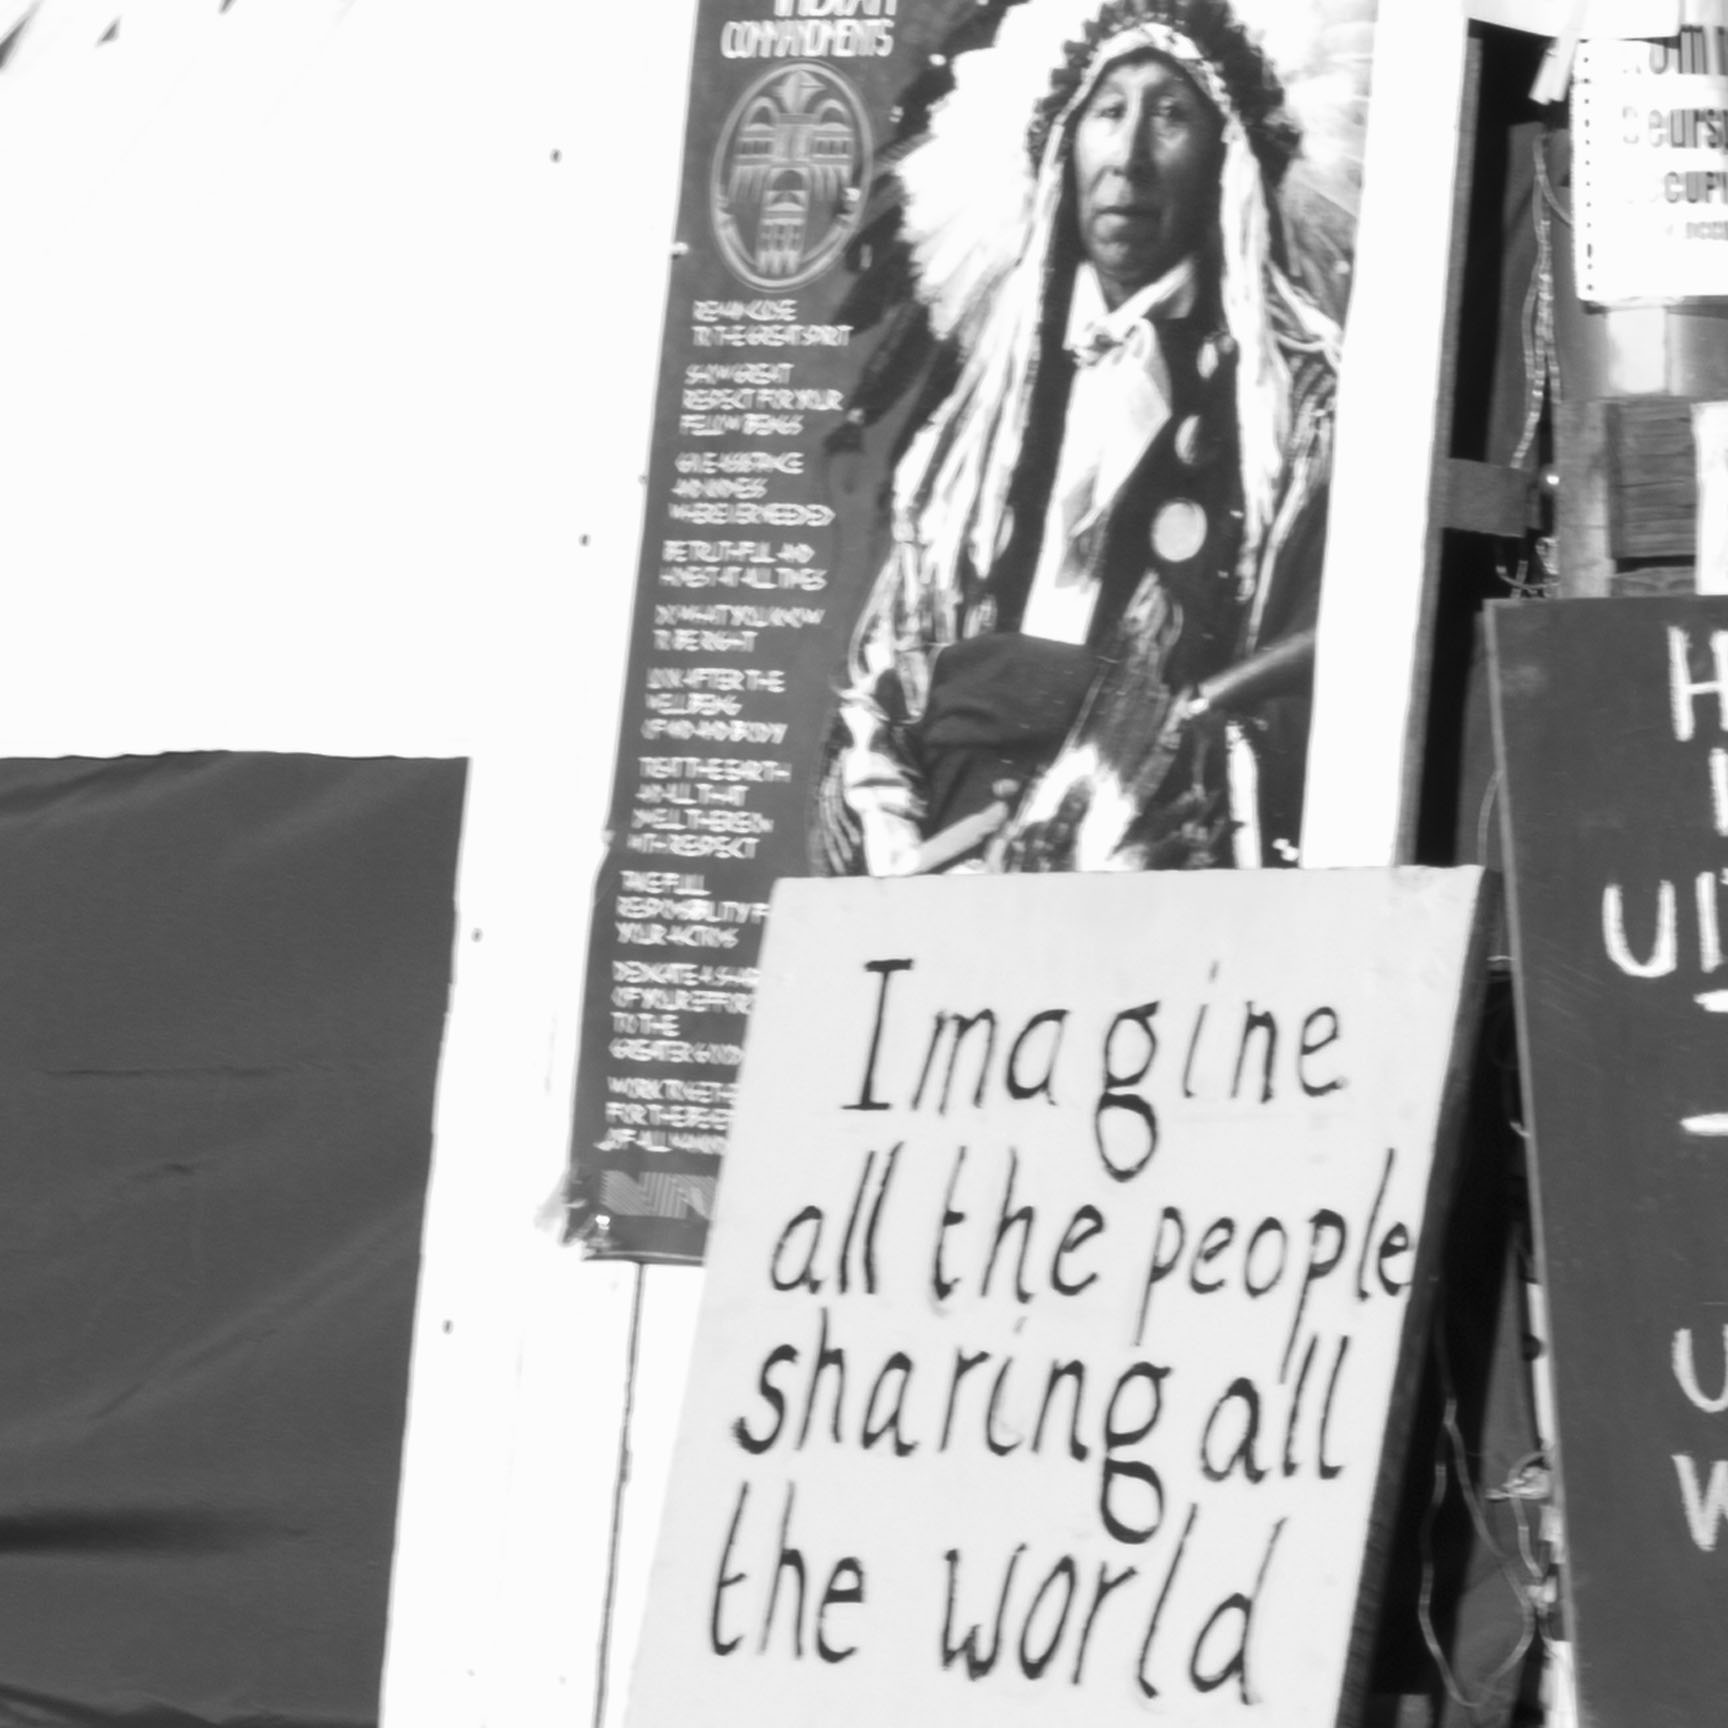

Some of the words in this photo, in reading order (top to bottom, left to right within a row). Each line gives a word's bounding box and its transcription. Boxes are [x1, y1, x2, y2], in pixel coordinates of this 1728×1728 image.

[840, 957, 1347, 1183] Imagine
[769, 1140, 905, 1294] all
[930, 1145, 1106, 1304] the
[1131, 1147, 1414, 1385] people
[731, 1304, 1172, 1545] sharing
[1200, 1333, 1351, 1484] all
[708, 1479, 866, 1664] the
[940, 1501, 1289, 1706] world
